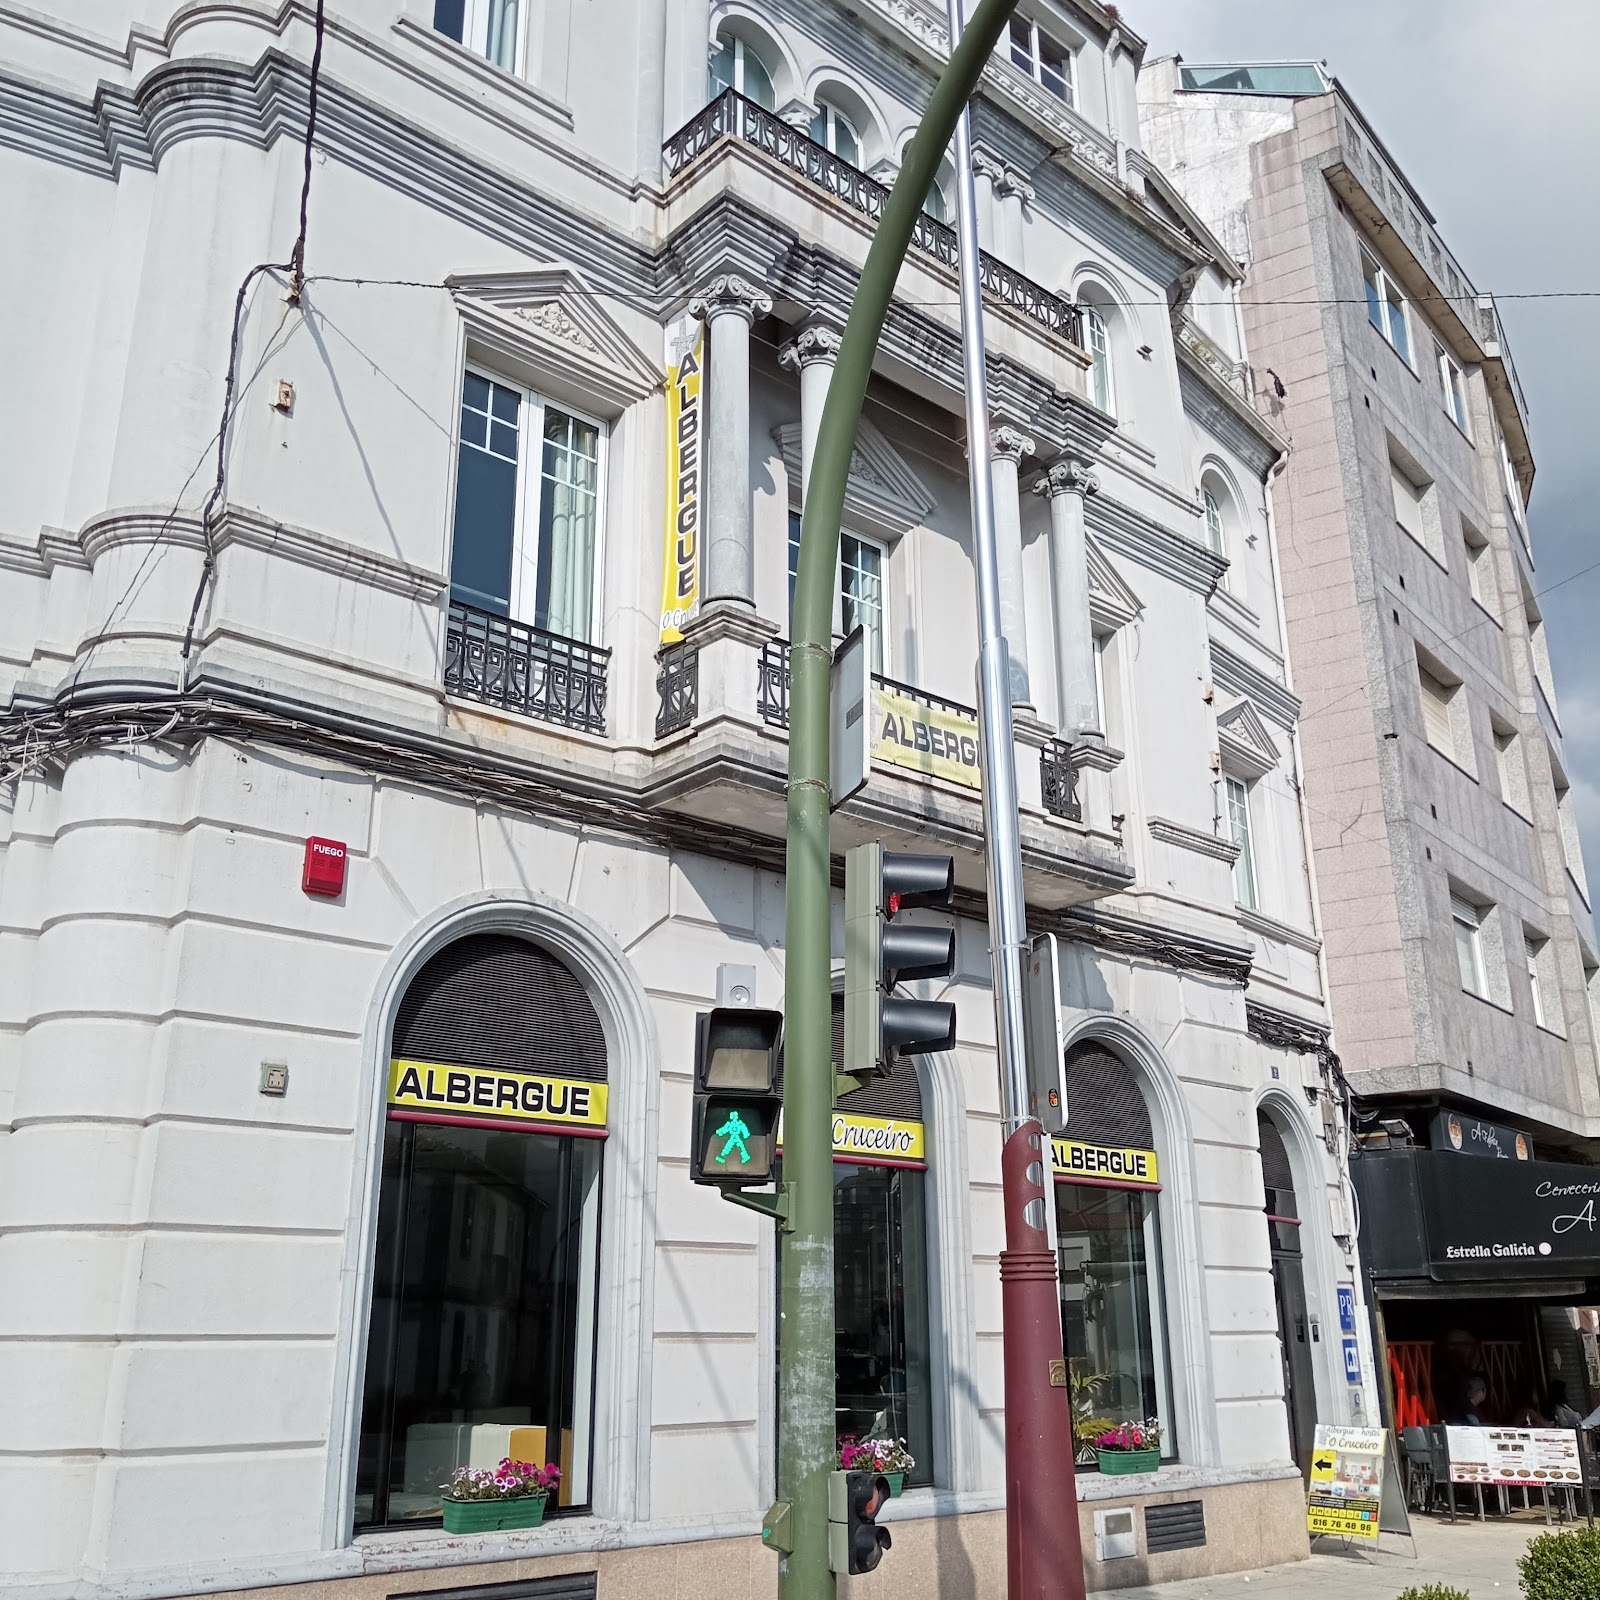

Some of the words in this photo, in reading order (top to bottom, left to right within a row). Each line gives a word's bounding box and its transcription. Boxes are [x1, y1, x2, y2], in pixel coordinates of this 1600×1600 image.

[676, 352, 699, 597] ALBERGUE
[881, 711, 980, 769] ALBERG
[313, 843, 344, 857] FUEGO
[395, 1067, 590, 1117] ALBERGUE
[832, 1118, 914, 1151] Cruceiro
[1446, 1245, 1491, 1258] Estrella
[1492, 1243, 1536, 1257] Galicia
[1329, 1437, 1337, 1447] O
[1339, 1438, 1379, 1450] Cruceiro
[1313, 1518, 1328, 1527] 616
